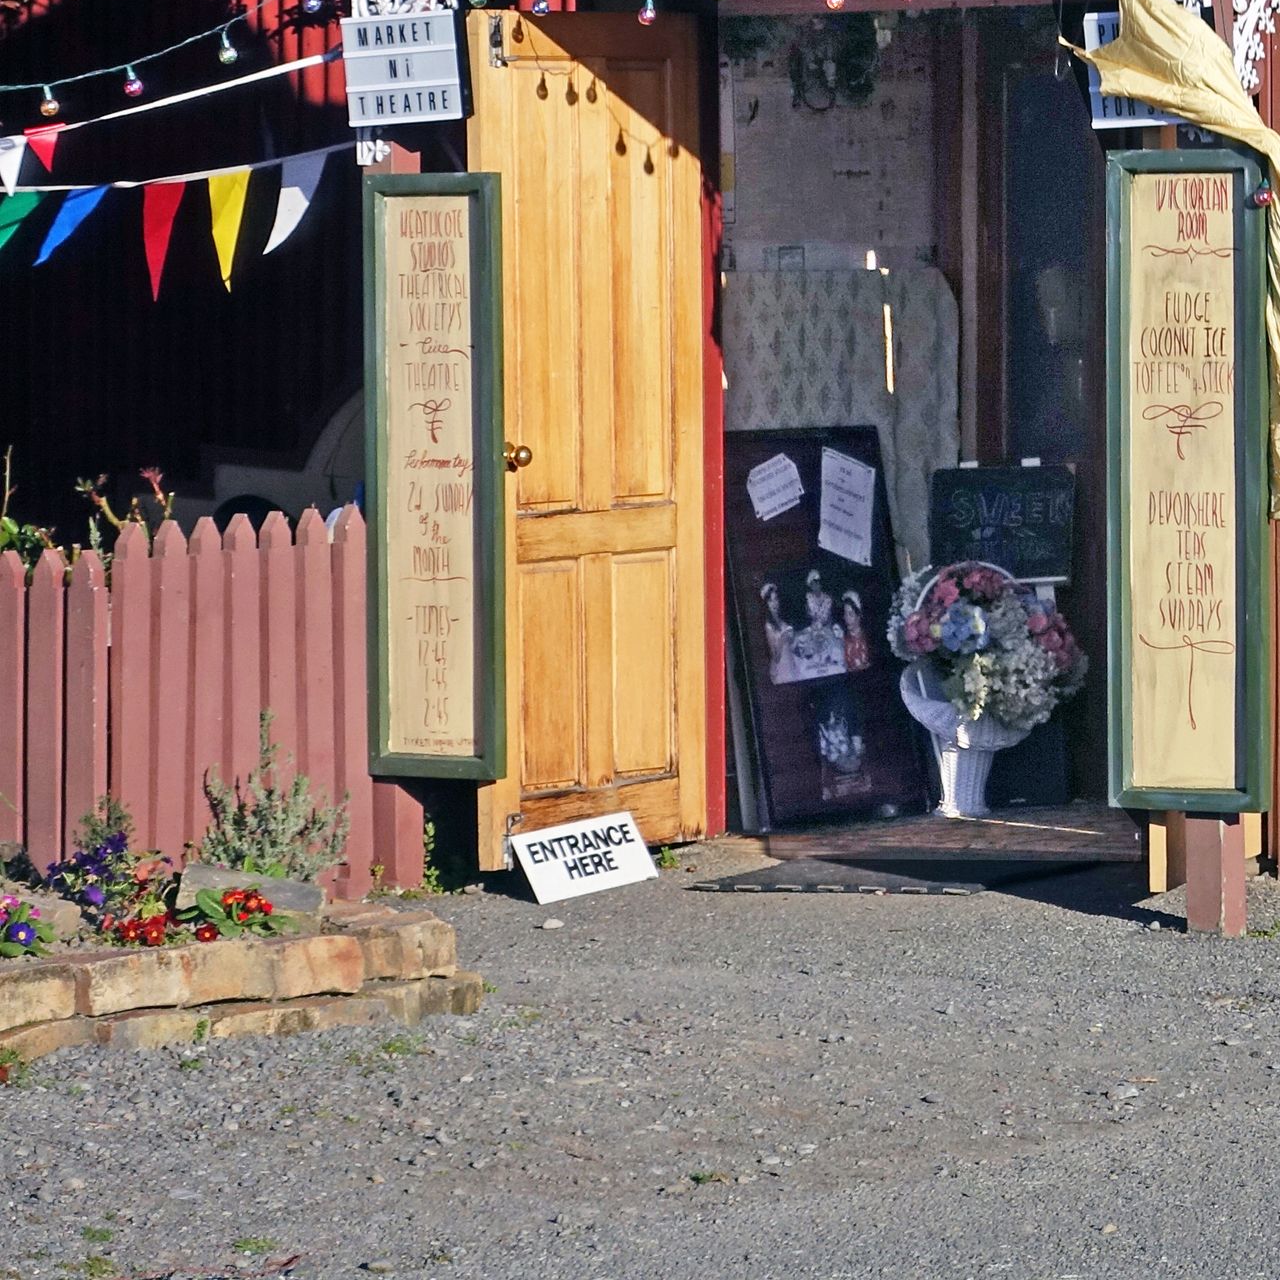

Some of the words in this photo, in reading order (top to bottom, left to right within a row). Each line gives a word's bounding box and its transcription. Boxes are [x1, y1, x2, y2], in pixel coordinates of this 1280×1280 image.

[357, 22, 432, 47] MARKET
[358, 90, 449, 115] THEATRE
[1155, 177, 1228, 213] VICTORIAN
[400, 209, 464, 238] HEATHCOTE
[1177, 211, 1209, 243] ROOM
[399, 273, 468, 299] THEATRICAL
[1165, 291, 1211, 323] FUDGE
[1141, 326, 1195, 358] COCONUT
[1203, 327, 1227, 358] ICE
[405, 362, 460, 392] THEATRE
[1134, 361, 1180, 395] TOFFEE
[1149, 491, 1226, 528] DEVONSHIRE
[413, 546, 450, 575] MONTH
[1176, 530, 1206, 560] TEAS
[1166, 561, 1214, 596] STEAM
[415, 605, 451, 637] TIMES
[1159, 598, 1223, 634] SUNDAYS
[526, 823, 635, 865] ENTRANCE
[563, 850, 619, 880] HERE
